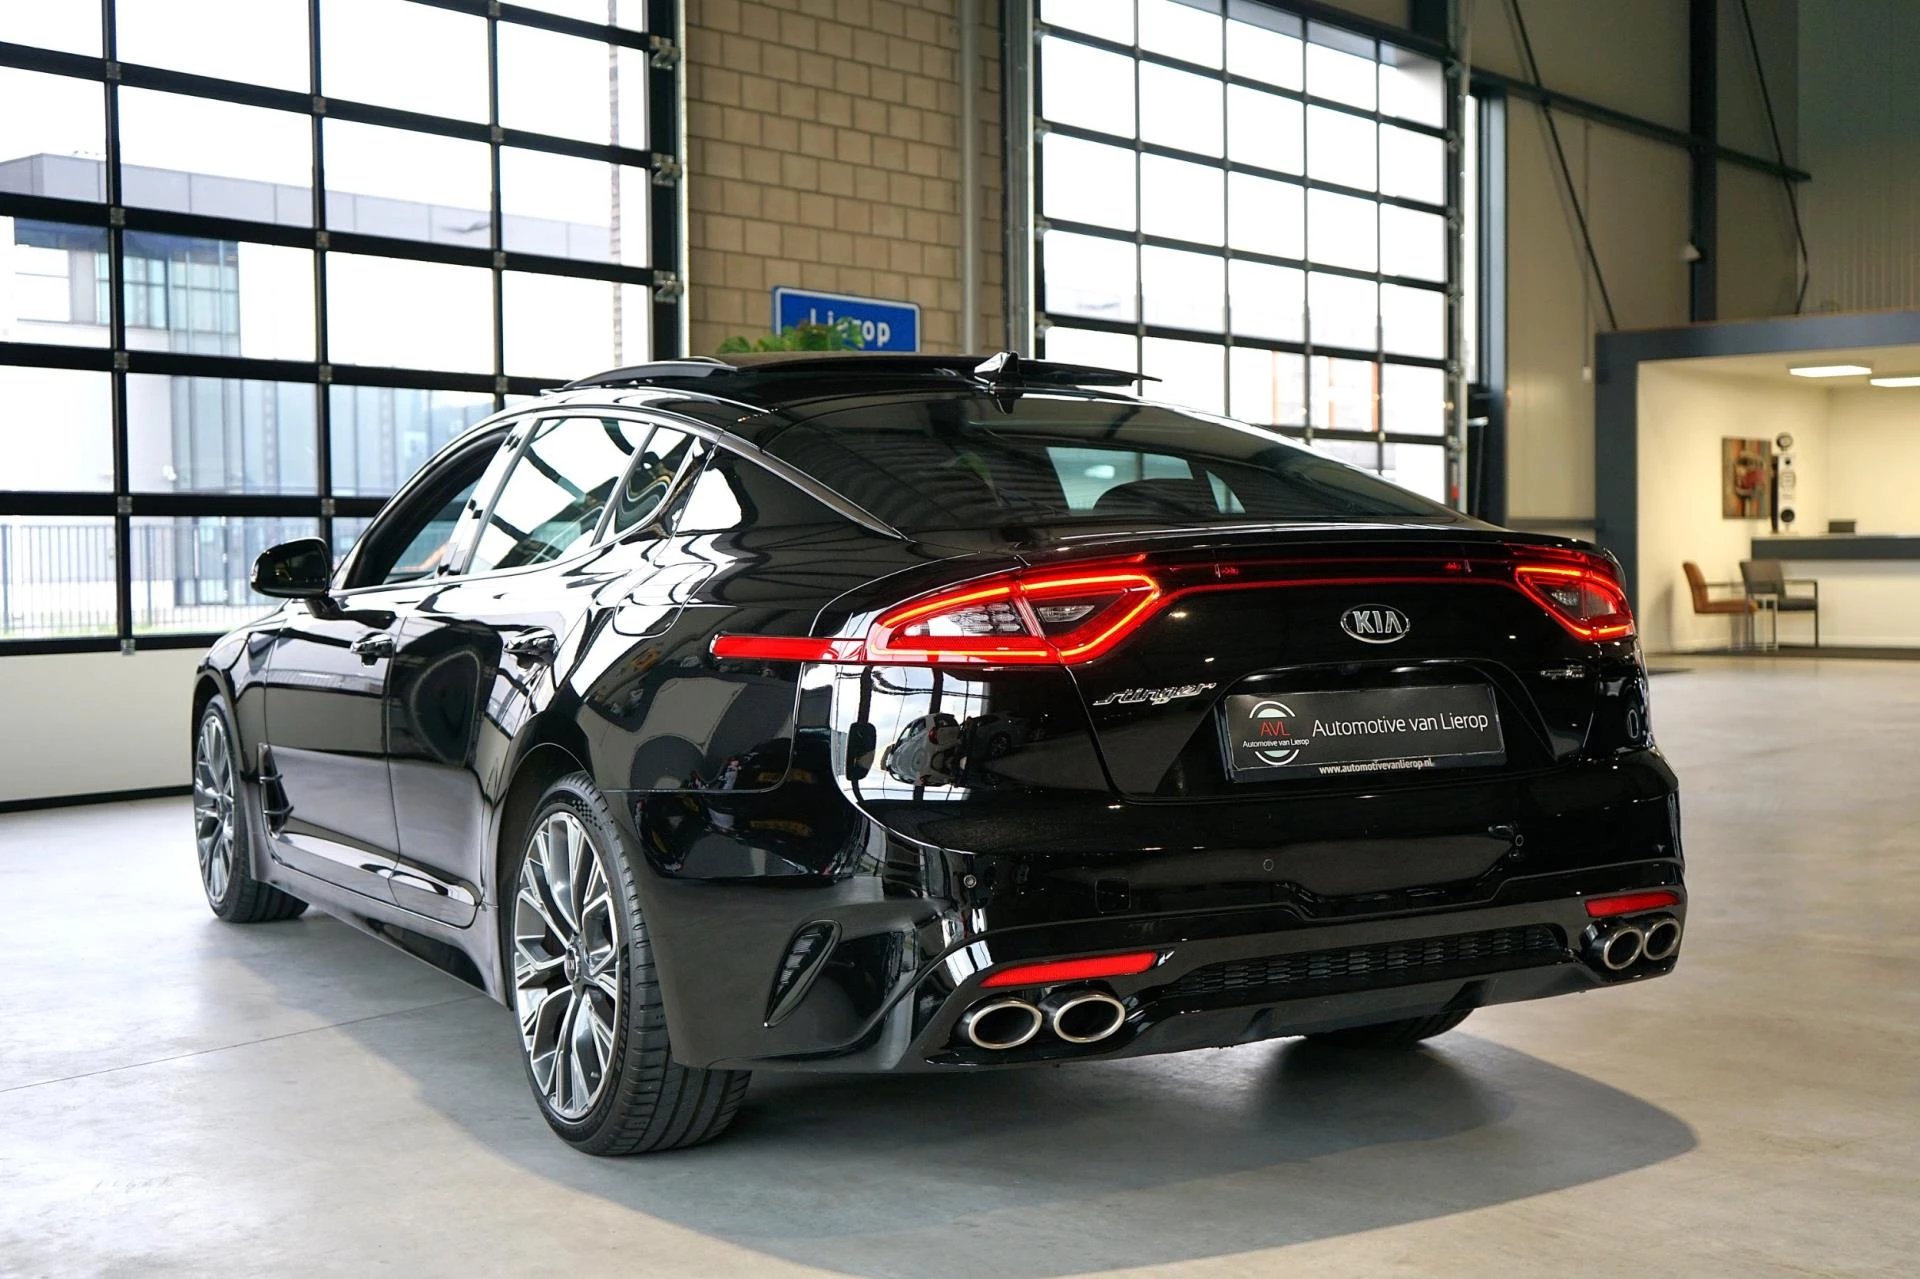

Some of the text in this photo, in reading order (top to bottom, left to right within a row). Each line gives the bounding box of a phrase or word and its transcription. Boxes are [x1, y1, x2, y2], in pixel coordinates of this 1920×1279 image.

[1352, 610, 1403, 633] KIA
[1260, 720, 1291, 737] AVL
[1312, 712, 1488, 737] Automotive van Lierop
[1242, 740, 1278, 748] Automotive
[1290, 738, 1310, 747] Lierop
[1319, 758, 1434, 775] www.automotivevanlierop.nl
[614, 975, 630, 1074] MICHELIN
